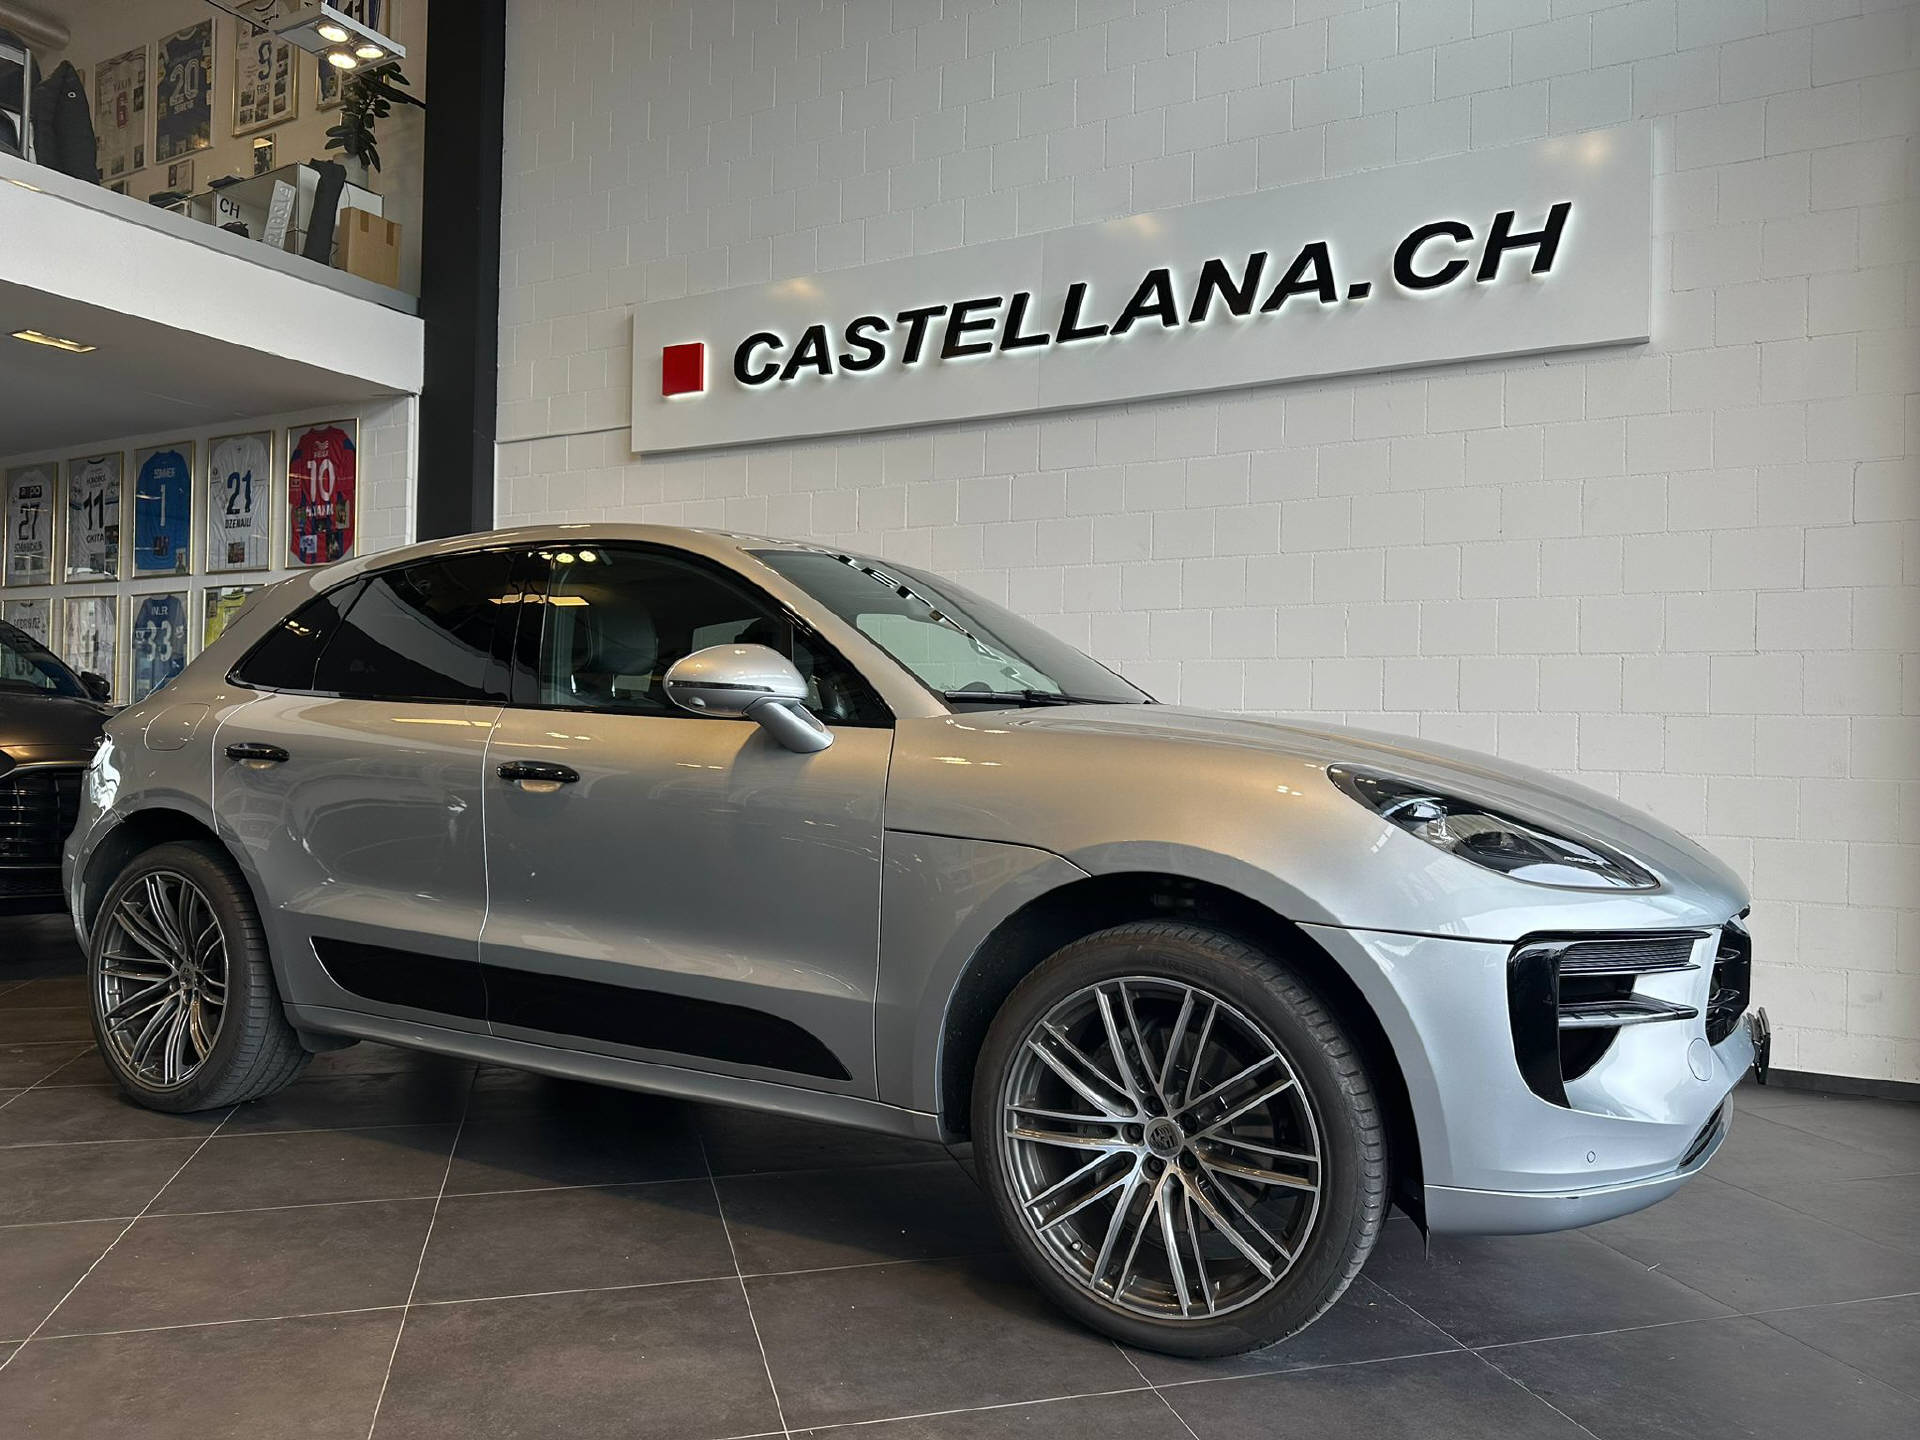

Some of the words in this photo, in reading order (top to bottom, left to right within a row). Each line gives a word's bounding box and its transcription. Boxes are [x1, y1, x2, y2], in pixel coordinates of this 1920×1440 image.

[169, 58, 200, 106] 20
[219, 198, 240, 219] CH
[733, 202, 1571, 388] CASTELLANA.CH
[226, 470, 251, 515] 21
[307, 459, 335, 501] 10
[18, 502, 40, 540] 27
[83, 489, 104, 530] 11
[146, 620, 172, 662] 33
